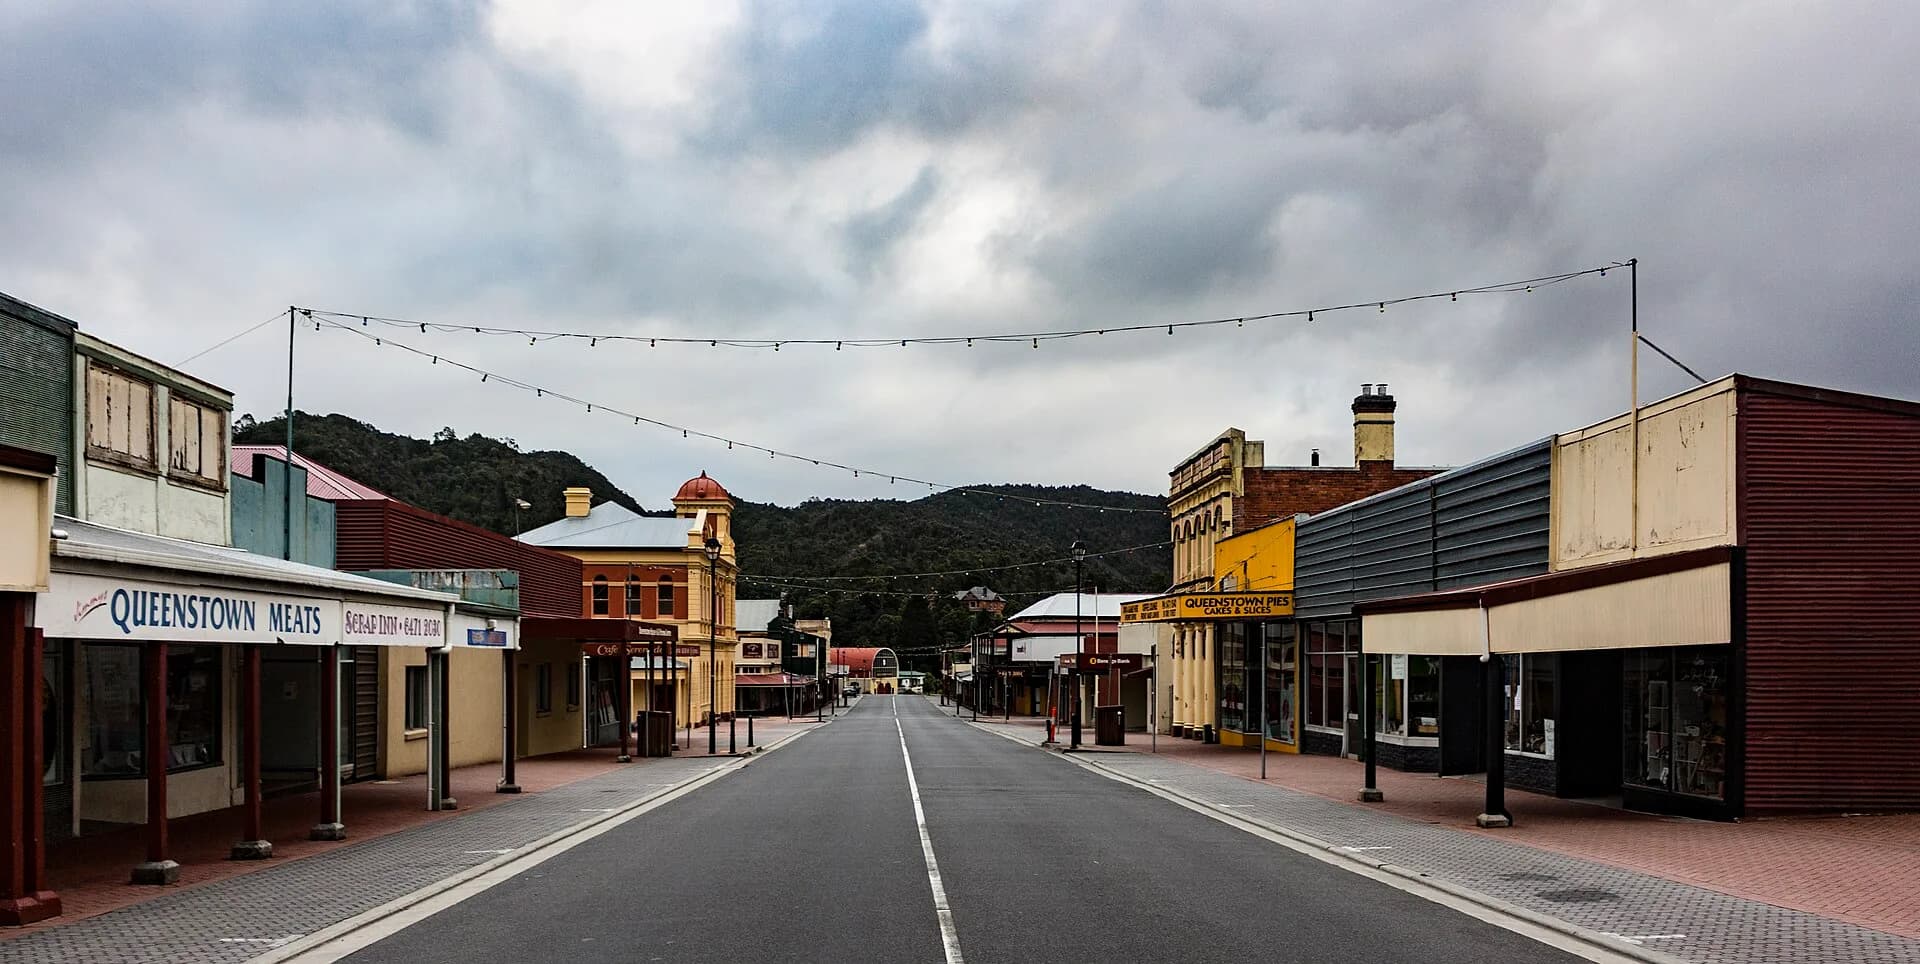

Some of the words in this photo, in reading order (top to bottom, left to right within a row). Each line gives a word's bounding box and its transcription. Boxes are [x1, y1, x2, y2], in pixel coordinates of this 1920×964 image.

[111, 588, 255, 634] QUEENSTOWN
[269, 602, 321, 635] MEATS
[1185, 597, 1265, 609] QUEENSTOWN
[1266, 596, 1289, 606] PIES
[1204, 607, 1232, 615] CAKES
[1235, 606, 1241, 614] &
[1243, 606, 1271, 614] SLICES
[345, 610, 377, 634] SCRAP
[378, 614, 398, 636] INN
